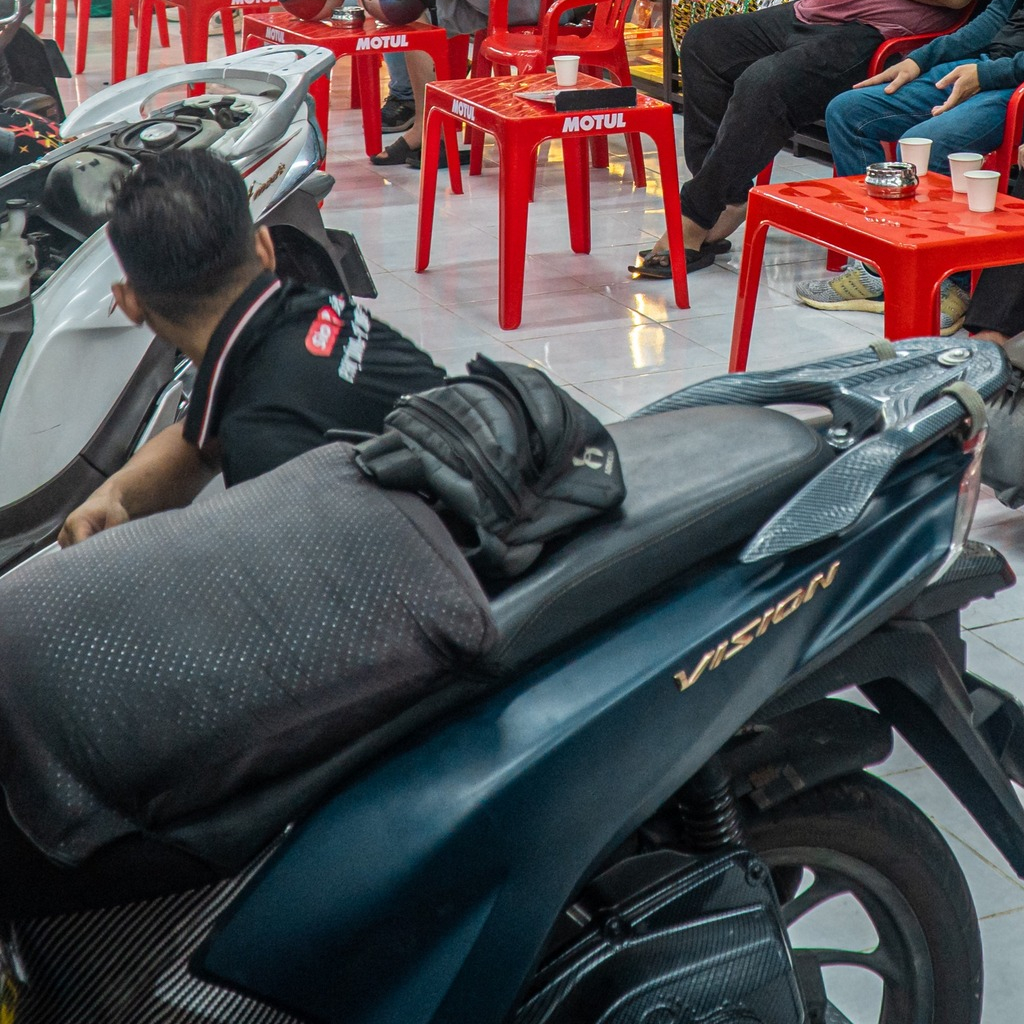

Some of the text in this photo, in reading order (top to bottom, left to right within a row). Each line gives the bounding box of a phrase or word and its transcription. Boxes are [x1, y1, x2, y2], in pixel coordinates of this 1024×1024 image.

[265, 26, 285, 44] MOTUL
[355, 34, 409, 51] MOTUL
[451, 98, 476, 122] MOTUL
[561, 112, 627, 133] MOTUL
[673, 560, 841, 693] VISION
